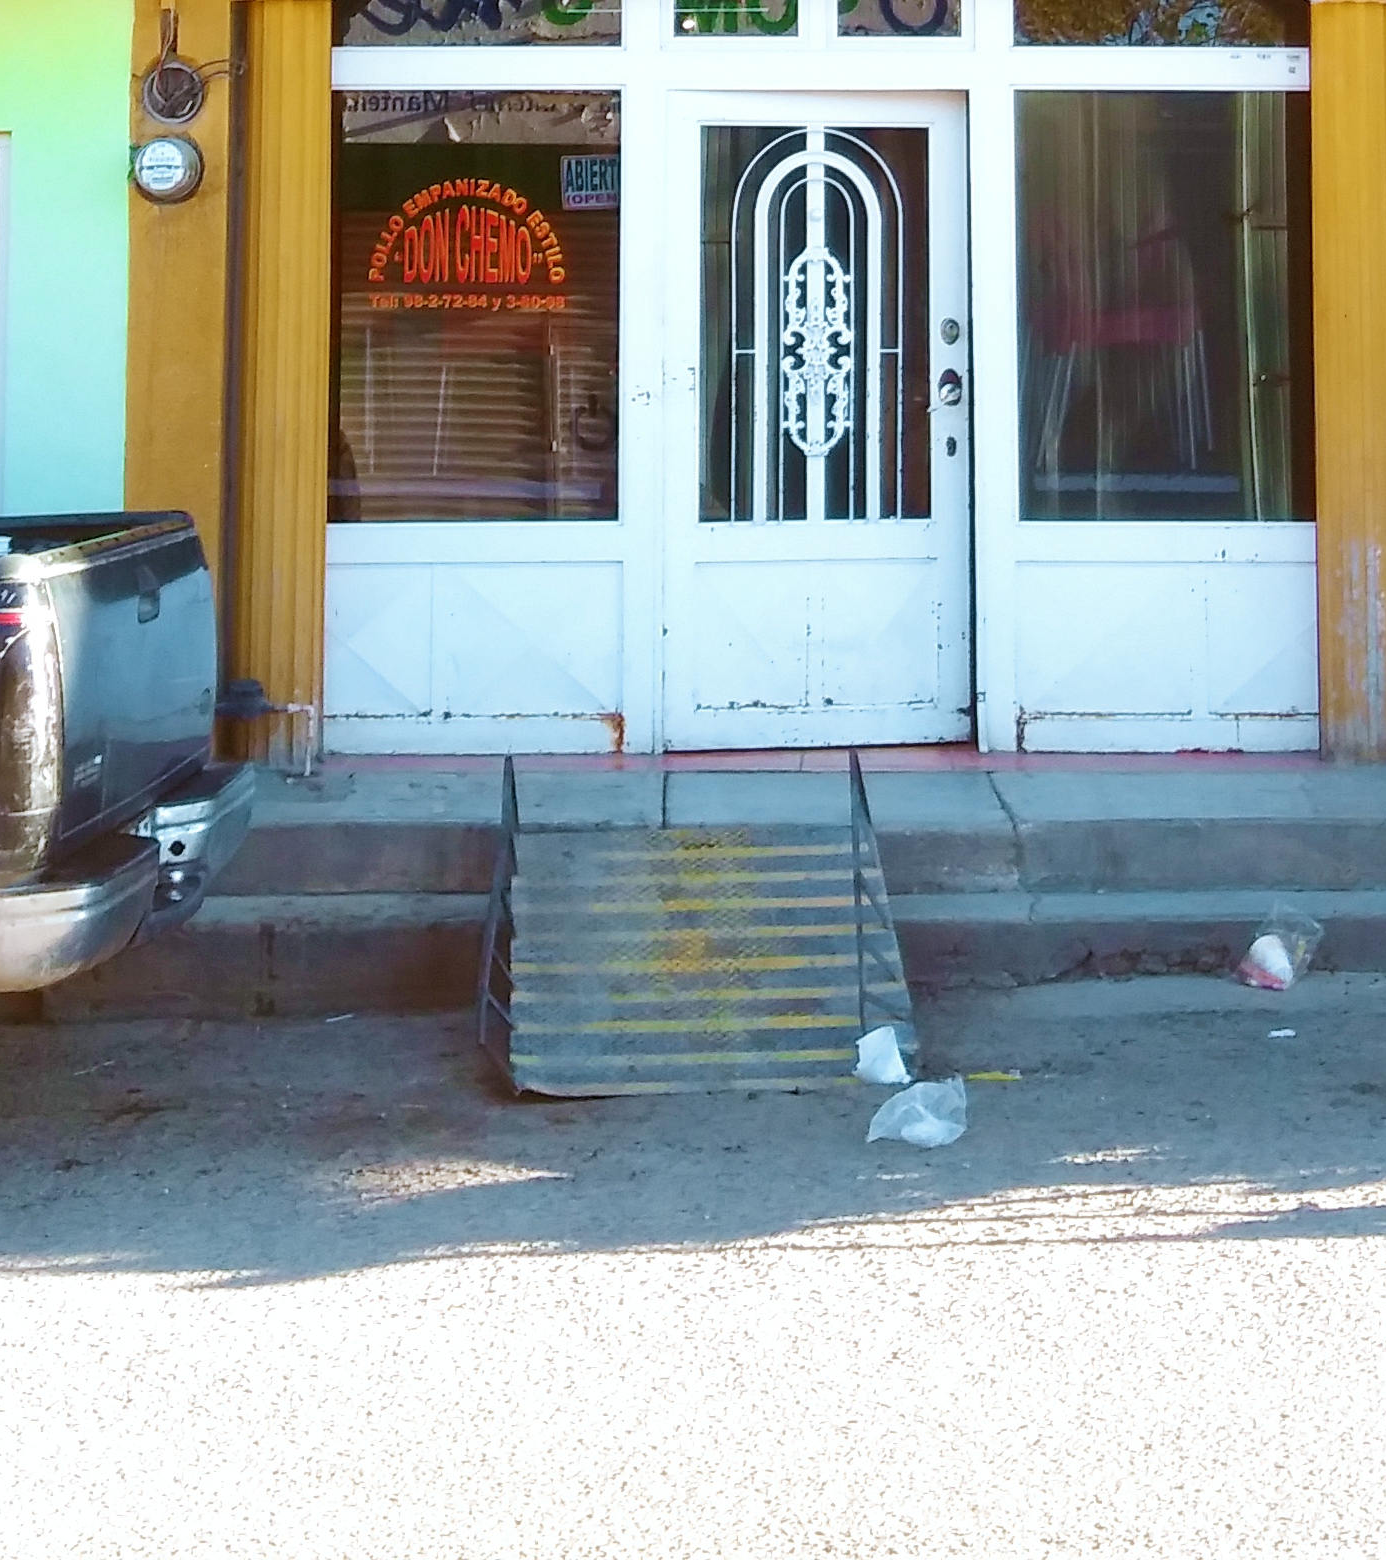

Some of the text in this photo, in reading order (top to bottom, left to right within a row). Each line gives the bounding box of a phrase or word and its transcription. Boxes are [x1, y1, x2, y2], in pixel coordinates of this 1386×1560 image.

[565, 158, 619, 193] ABIERT
[368, 177, 566, 284] POLLO EMPANIZADO ESTILO
[492, 297, 502, 312] y
